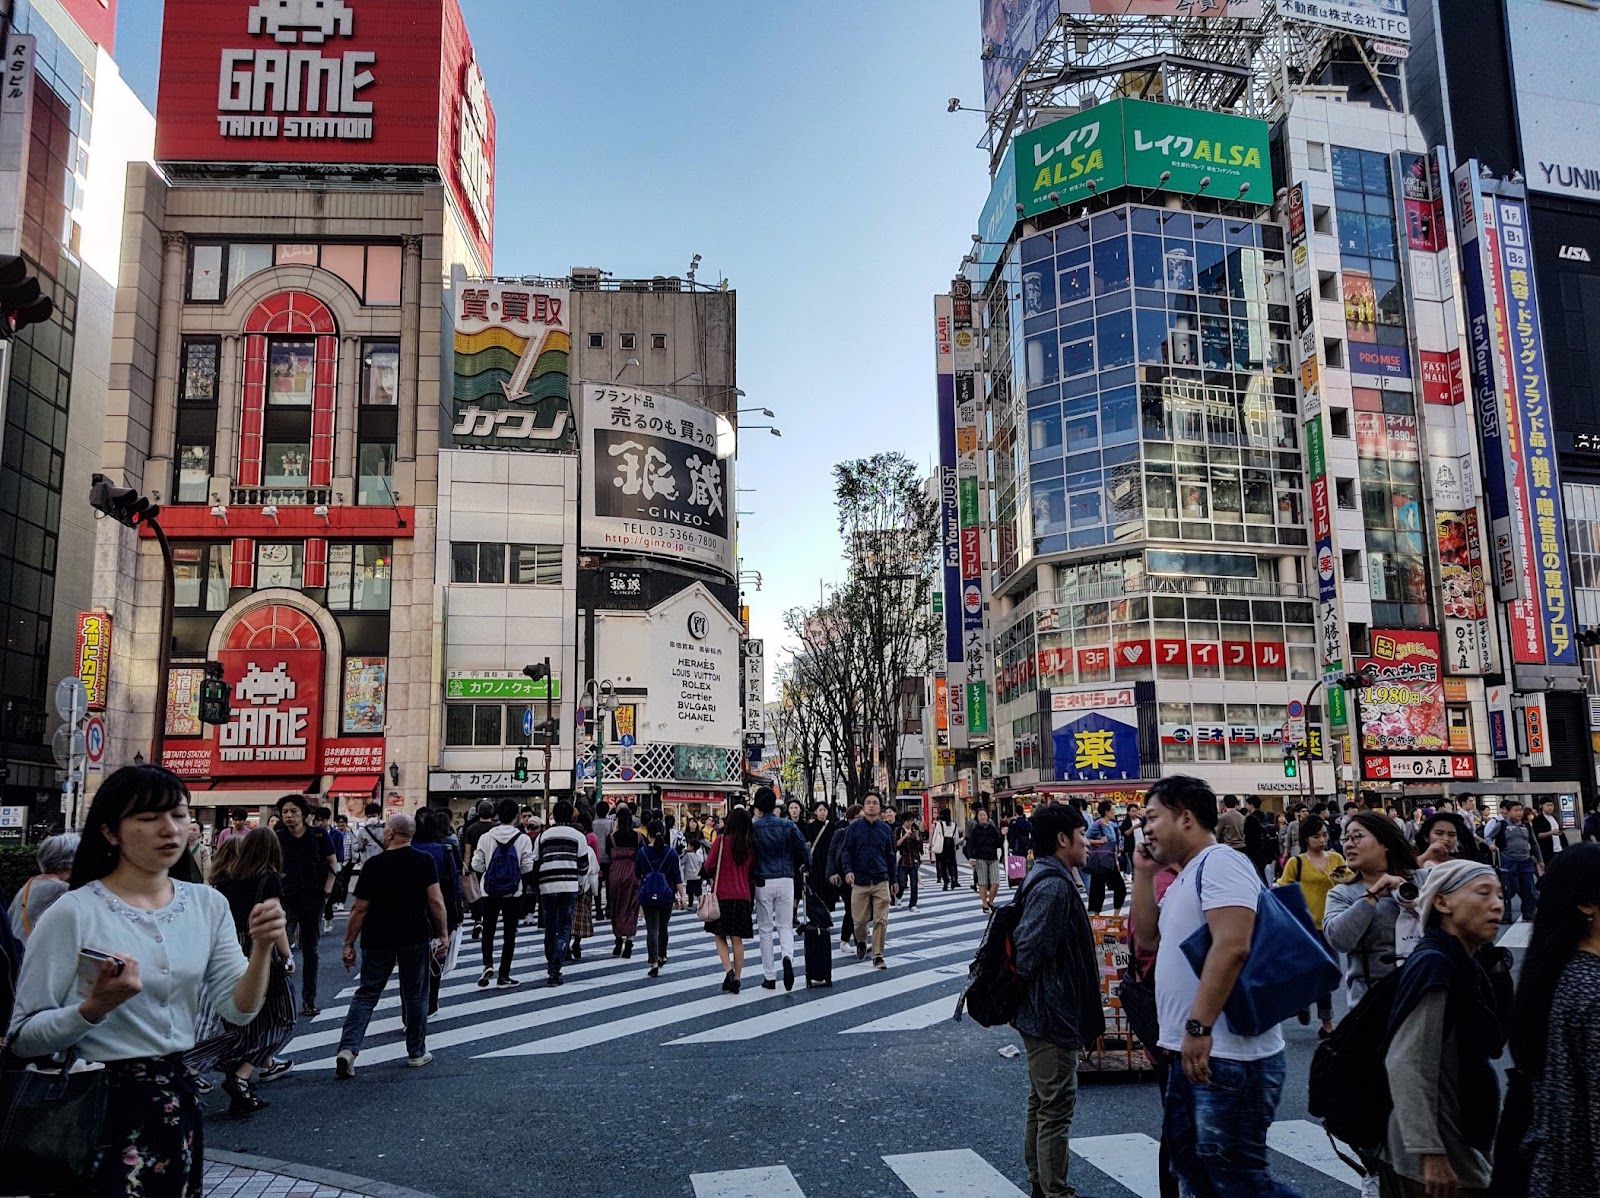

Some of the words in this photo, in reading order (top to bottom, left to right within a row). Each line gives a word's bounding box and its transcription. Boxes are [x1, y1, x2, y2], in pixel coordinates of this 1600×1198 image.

[1281, 1, 1408, 34] 不動産は株式会社TFC
[9, 44, 26, 100] RSビル
[217, 48, 376, 114] GAME
[217, 116, 279, 138] TAITO
[283, 117, 373, 139] STATION
[1033, 121, 1100, 167] レイク
[1133, 129, 1262, 170] レイクALSA
[1032, 148, 1104, 192] ALSA
[1462, 191, 1474, 224] LABI
[1507, 230, 1521, 242] B1
[1509, 252, 1524, 264] B2
[1558, 245, 1591, 262] LISA
[461, 288, 563, 326] 質・買取
[938, 317, 947, 342] LABI
[1473, 314, 1486, 341] For
[1359, 351, 1401, 366] PROMISE
[1423, 362, 1446, 373] FAST
[1474, 340, 1490, 380] Your
[1374, 377, 1390, 387] 7F
[1424, 372, 1448, 382] NAIL
[594, 389, 655, 409] ブランド品
[1439, 392, 1449, 400] 6F
[451, 405, 568, 439] カワノ
[1386, 415, 1415, 428] ネイル
[1479, 386, 1500, 438] JUST
[610, 406, 717, 448] 売るのも買うの
[607, 440, 724, 518] 銀蔵
[942, 465, 958, 508] JUST
[1435, 492, 1461, 500] Rydia
[1314, 483, 1329, 535] アイフル
[605, 533, 684, 551] http://ginzo.jp
[622, 522, 717, 549] TEL.03-5366-7800
[946, 516, 958, 545] Your
[946, 547, 958, 567] For
[964, 530, 979, 575] アイフル
[1319, 555, 1333, 573] 薬
[1502, 550, 1514, 584] LABI
[965, 592, 980, 607] 薬
[1323, 602, 1341, 660] 大勝軒
[82, 617, 101, 702] ネットカフェ
[677, 658, 716, 671] HERMÈS
[966, 632, 985, 679] 大勝軒
[1085, 652, 1105, 665] 3F
[1163, 643, 1280, 665] アイフル
[672, 668, 691, 678] LOUIS
[694, 671, 721, 681] VUITTON
[681, 680, 712, 691] ROLEX
[677, 701, 717, 712] BVLGARI
[680, 691, 713, 702] Cartier
[951, 685, 959, 712] LABI
[1333, 688, 1342, 718] ALSA
[618, 706, 630, 715] 2F
[678, 712, 716, 722] CHANEL
[218, 707, 309, 746] GAME
[1494, 714, 1504, 748] PROMISE
[1528, 711, 1541, 749] 吉野家
[219, 747, 251, 762] TAITO
[256, 747, 306, 761] STATION
[1074, 729, 1117, 770] 薬
[1412, 758, 1451, 777] 日高屋
[1456, 757, 1470, 769] 24
[469, 773, 547, 785] カワノ・トス
[1257, 782, 1308, 791] PANDORA
[1561, 796, 1568, 808] P
